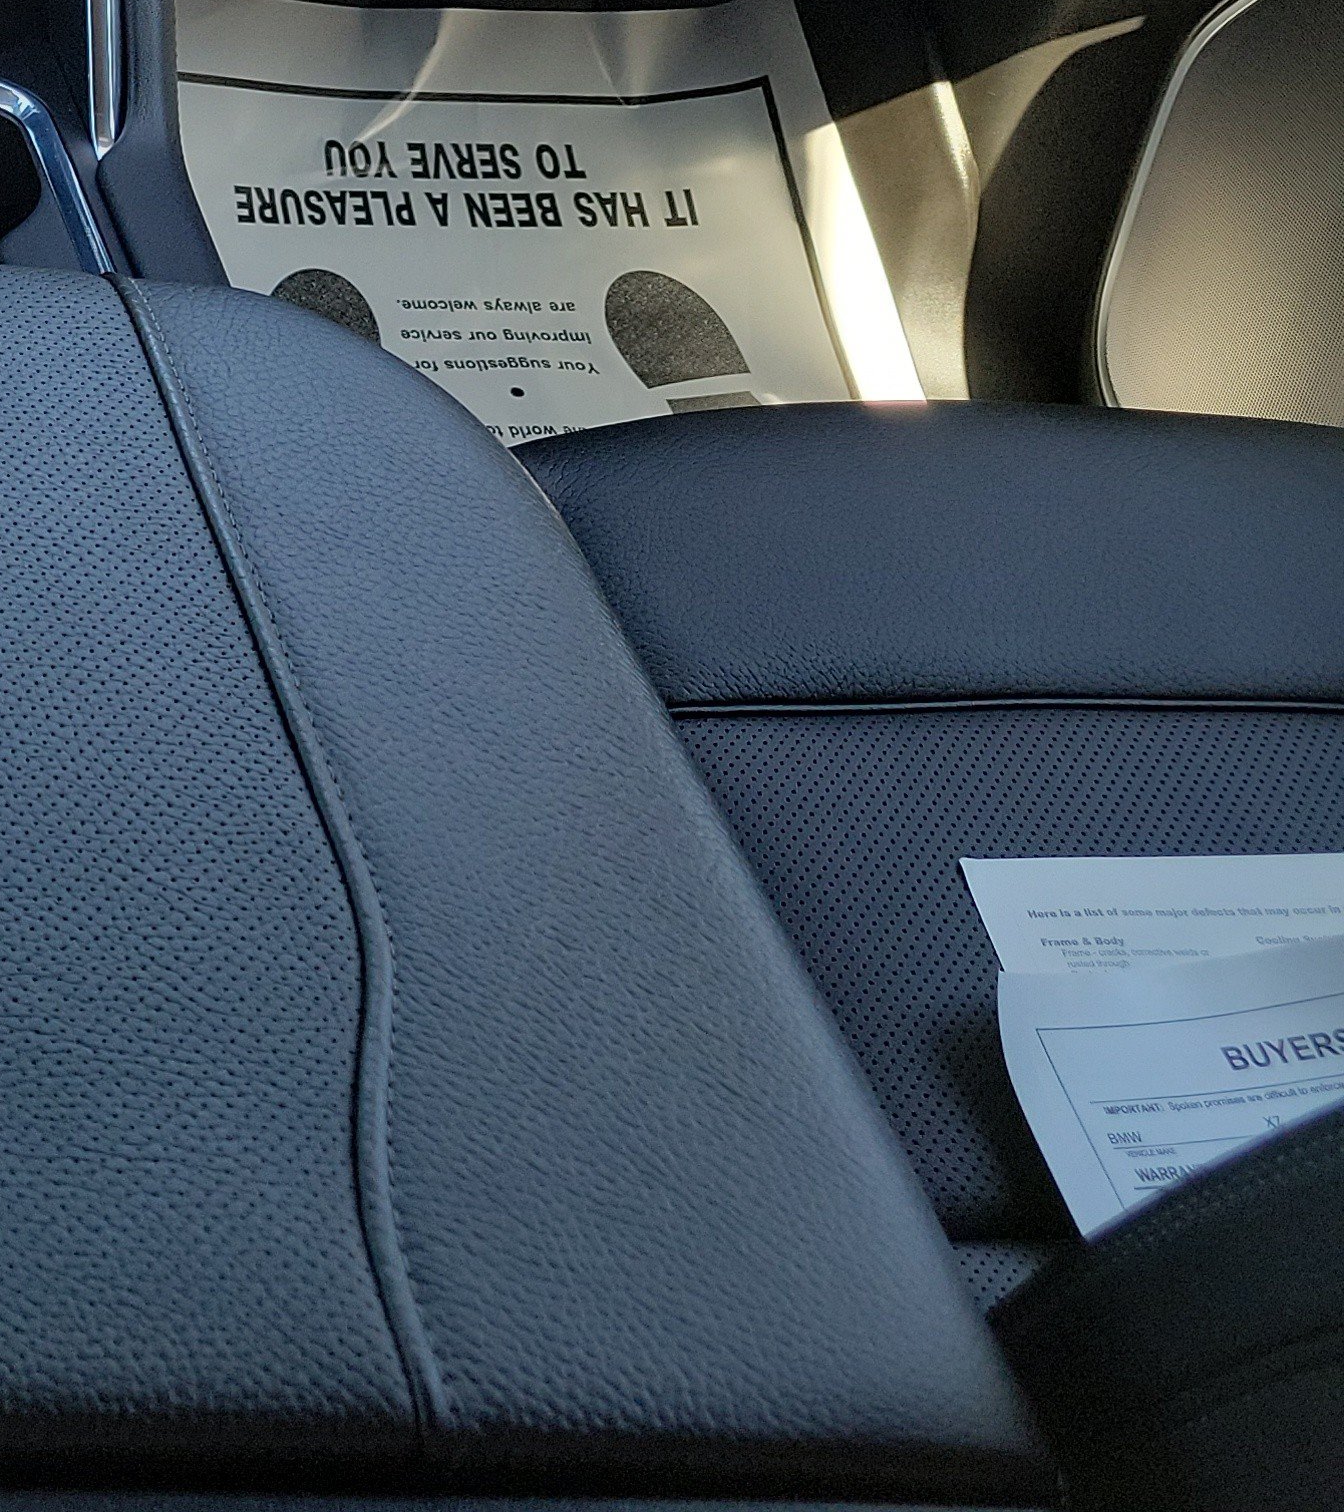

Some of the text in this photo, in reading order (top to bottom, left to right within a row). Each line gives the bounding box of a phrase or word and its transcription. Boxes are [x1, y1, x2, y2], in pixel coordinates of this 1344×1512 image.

[324, 139, 587, 179] TO SERVE YOU
[234, 185, 699, 228] IT HAS BEEN A PLEASURE
[396, 298, 576, 314] are always welcome.
[400, 328, 592, 345] improving our service
[414, 356, 600, 375] Your suggestions for
[511, 425, 558, 439] world
[1026, 909, 1058, 920] Here
[1084, 907, 1104, 918] list
[1107, 907, 1118, 917] of
[1121, 909, 1153, 917] some
[1155, 907, 1189, 919] major
[1191, 907, 1236, 917] defects
[1237, 906, 1263, 916] that
[1264, 906, 1289, 917] may
[1292, 905, 1326, 915] occur
[1328, 904, 1342, 914] in
[1040, 937, 1079, 947] Frame
[1095, 936, 1125, 947] Body
[1167, 1100, 1203, 1113] Spoken
[1204, 1095, 1246, 1109] promises
[1264, 1088, 1298, 1100] difficult
[1107, 1131, 1142, 1144] BMW
